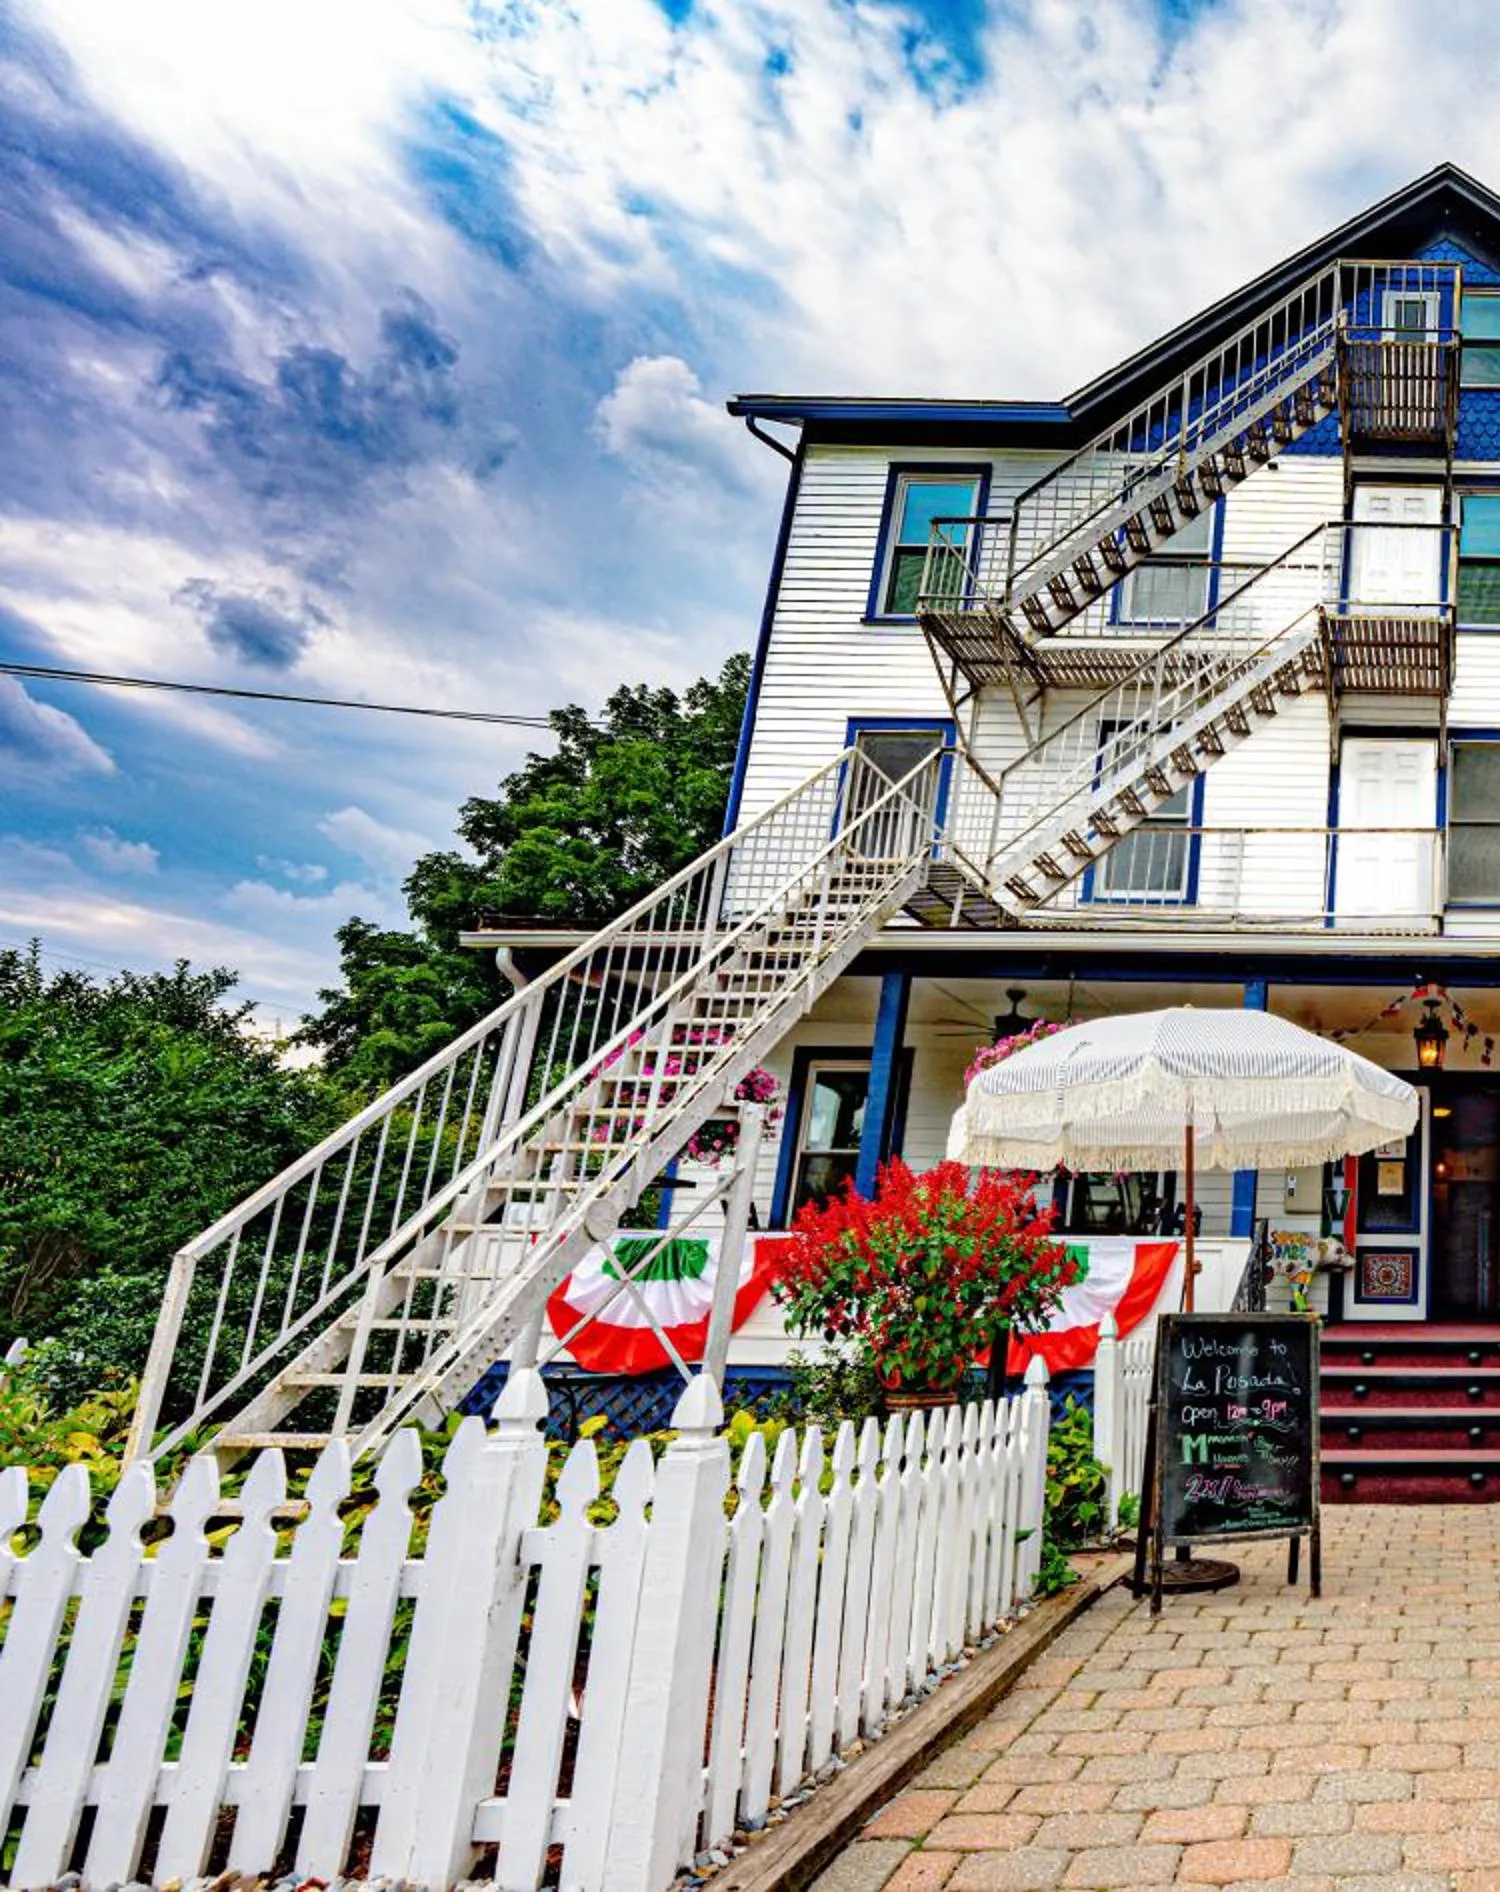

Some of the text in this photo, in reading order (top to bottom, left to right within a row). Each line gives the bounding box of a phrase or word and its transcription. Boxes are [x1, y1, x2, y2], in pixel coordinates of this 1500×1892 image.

[1181, 1337, 1288, 1360] Welcome to
[1181, 1365, 1208, 1392] La
